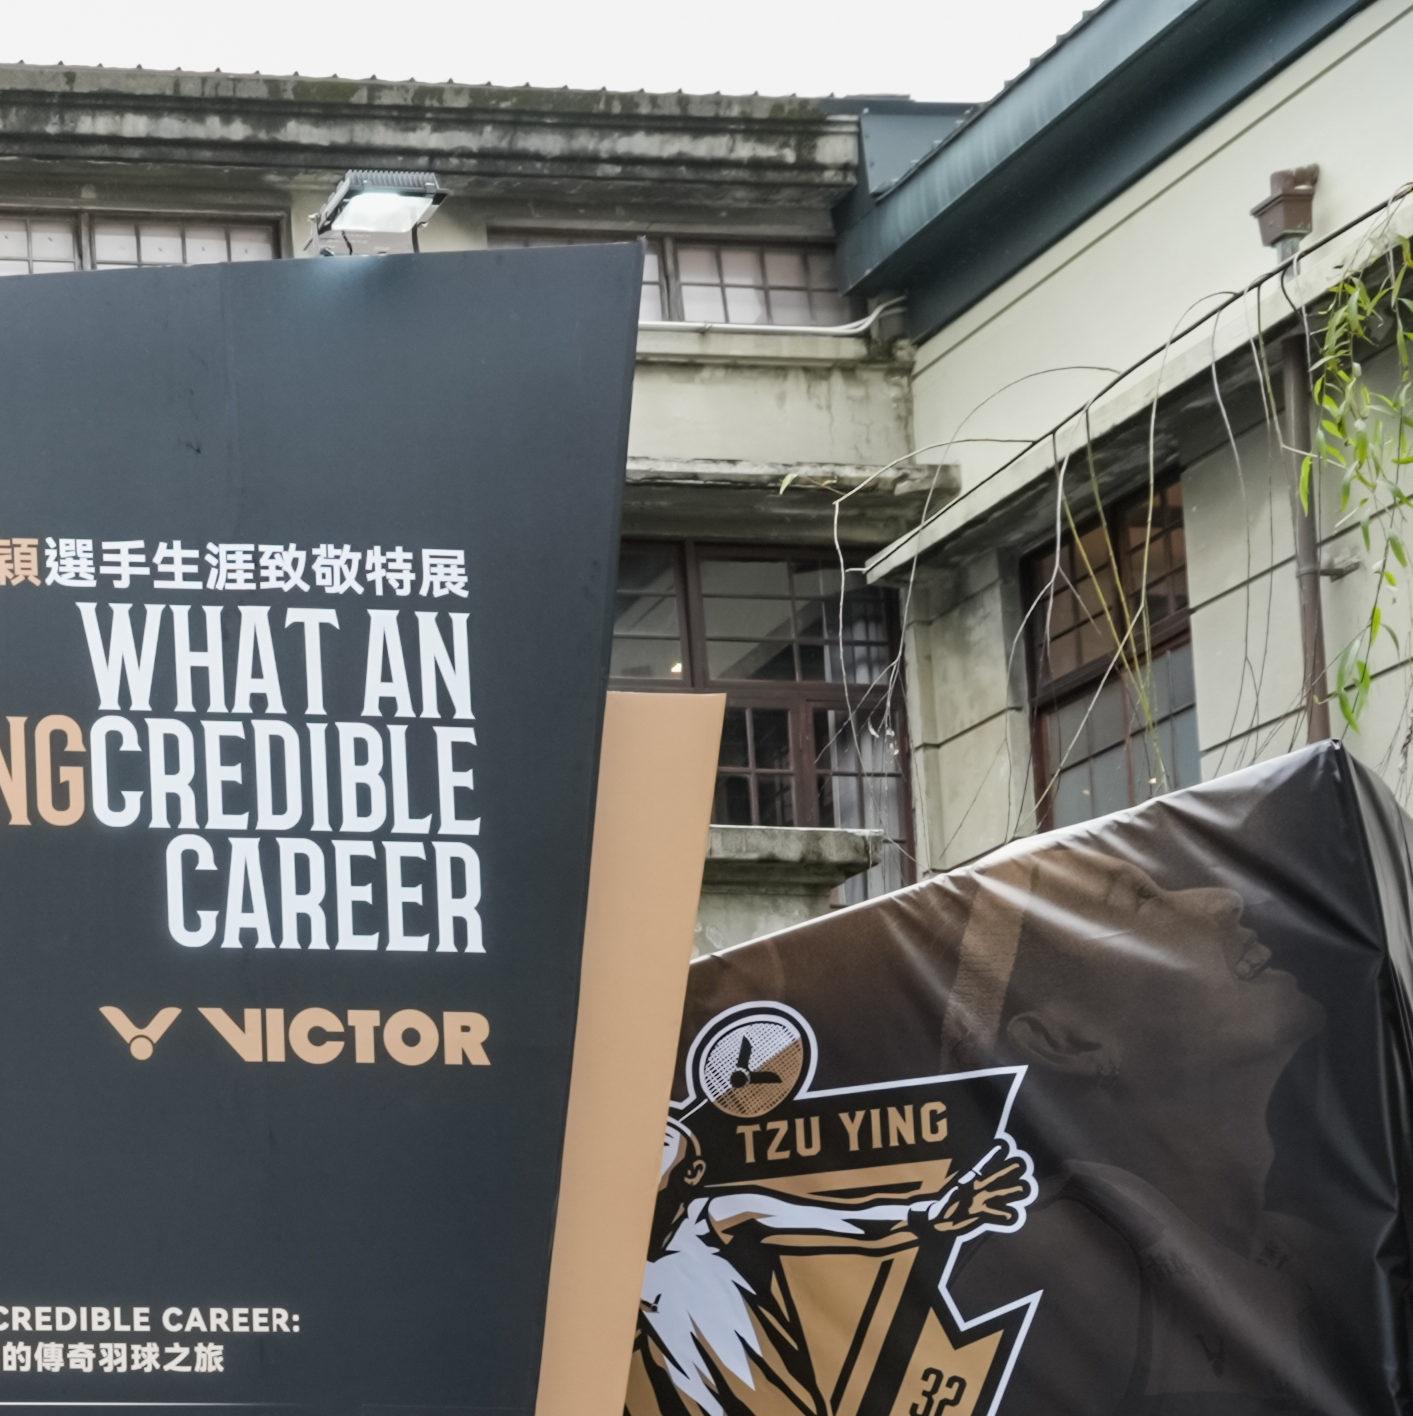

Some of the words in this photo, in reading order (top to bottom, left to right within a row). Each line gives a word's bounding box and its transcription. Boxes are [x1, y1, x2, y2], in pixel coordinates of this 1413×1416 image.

[76, 602, 339, 715] WHAT
[361, 609, 475, 719] AN
[166, 834, 486, 953] CAREER
[198, 1007, 491, 1066] VICTOR
[737, 1115, 821, 1164] TZU
[839, 1101, 949, 1154] YING
[162, 1307, 300, 1333] CAREER:
